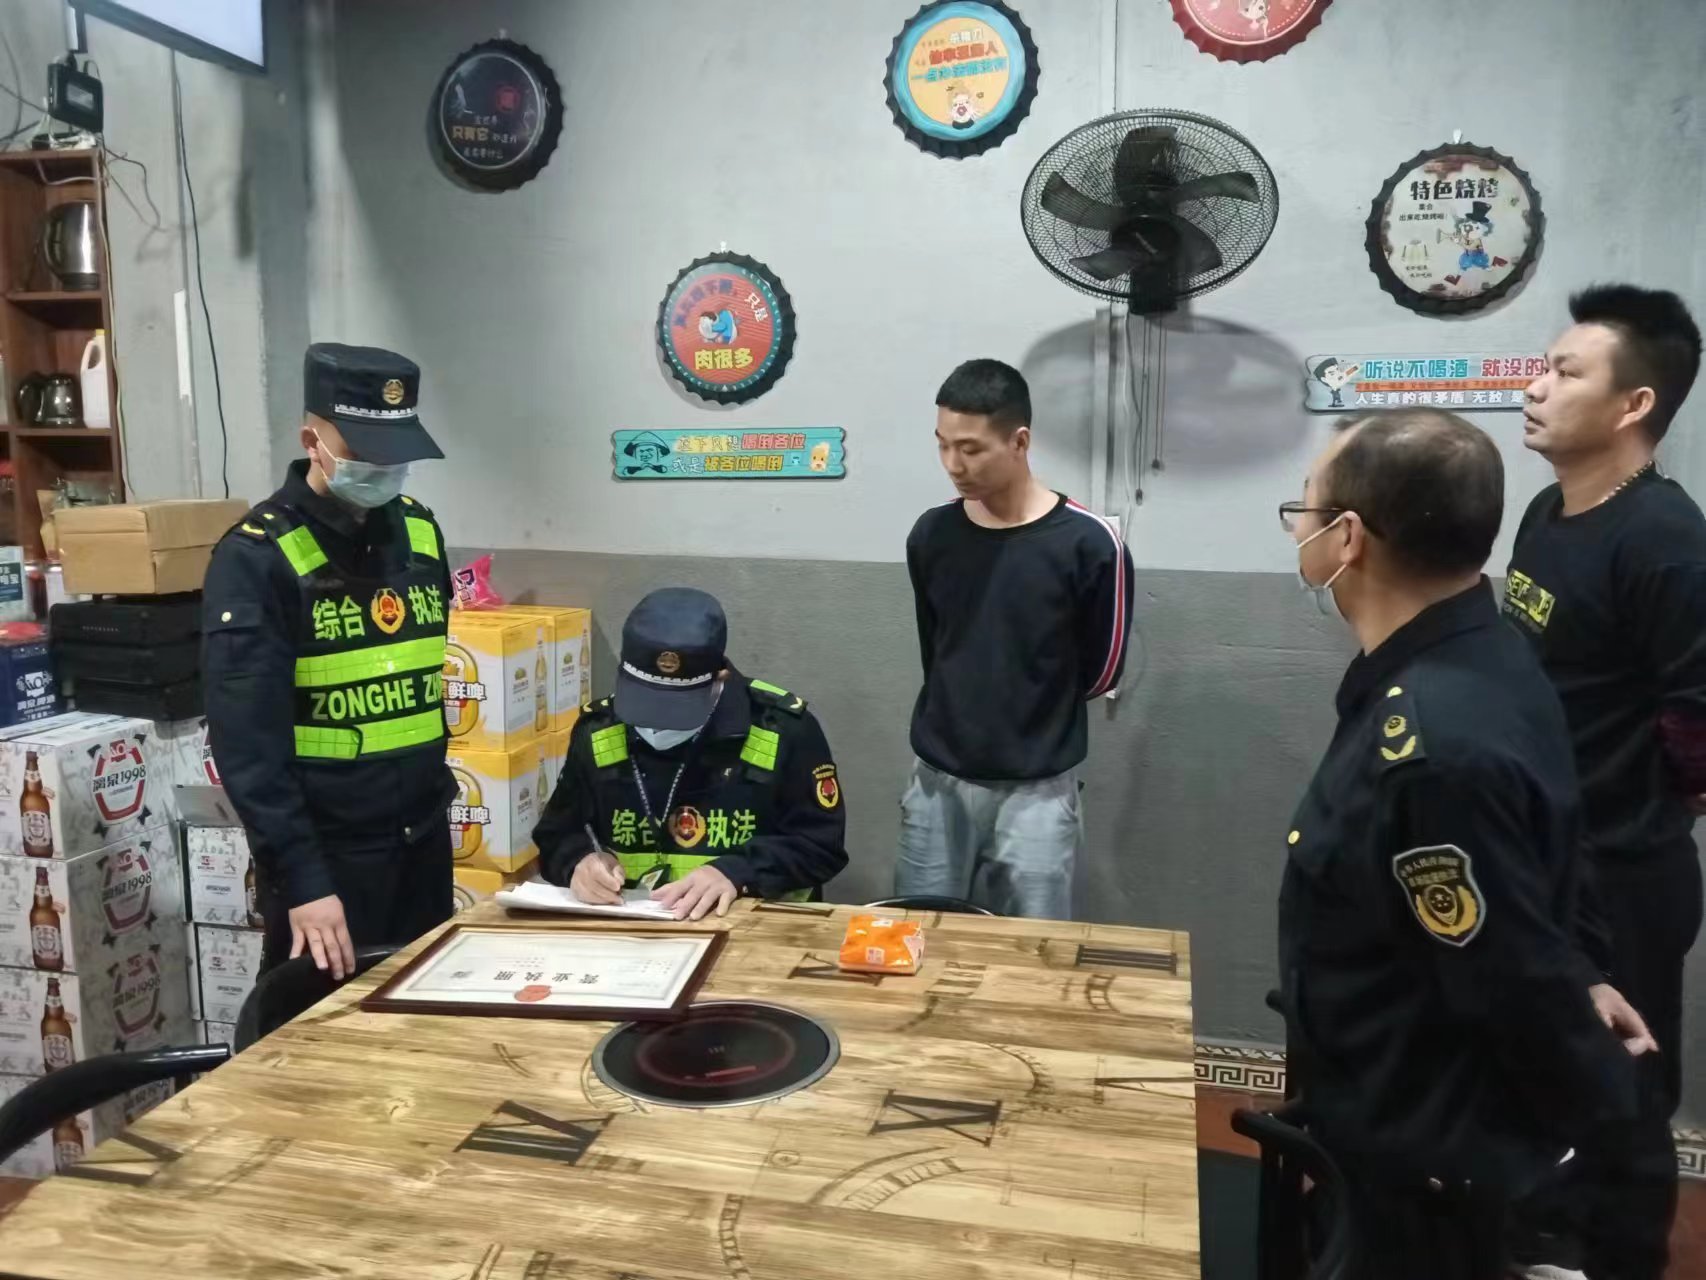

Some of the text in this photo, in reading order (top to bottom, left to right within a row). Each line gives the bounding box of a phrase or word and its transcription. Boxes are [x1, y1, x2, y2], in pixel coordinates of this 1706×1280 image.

[1410, 177, 1499, 201] 特色烧烤
[694, 347, 753, 371] 肉很多
[1364, 359, 1469, 379] 听说不喝酒
[1355, 391, 1465, 405] 人生真的很矛盾
[1472, 391, 1503, 404] 无敌
[312, 597, 366, 640] 综合
[408, 584, 445, 626] 执法
[310, 677, 417, 721] ZONGHE
[706, 808, 757, 849] 执法
